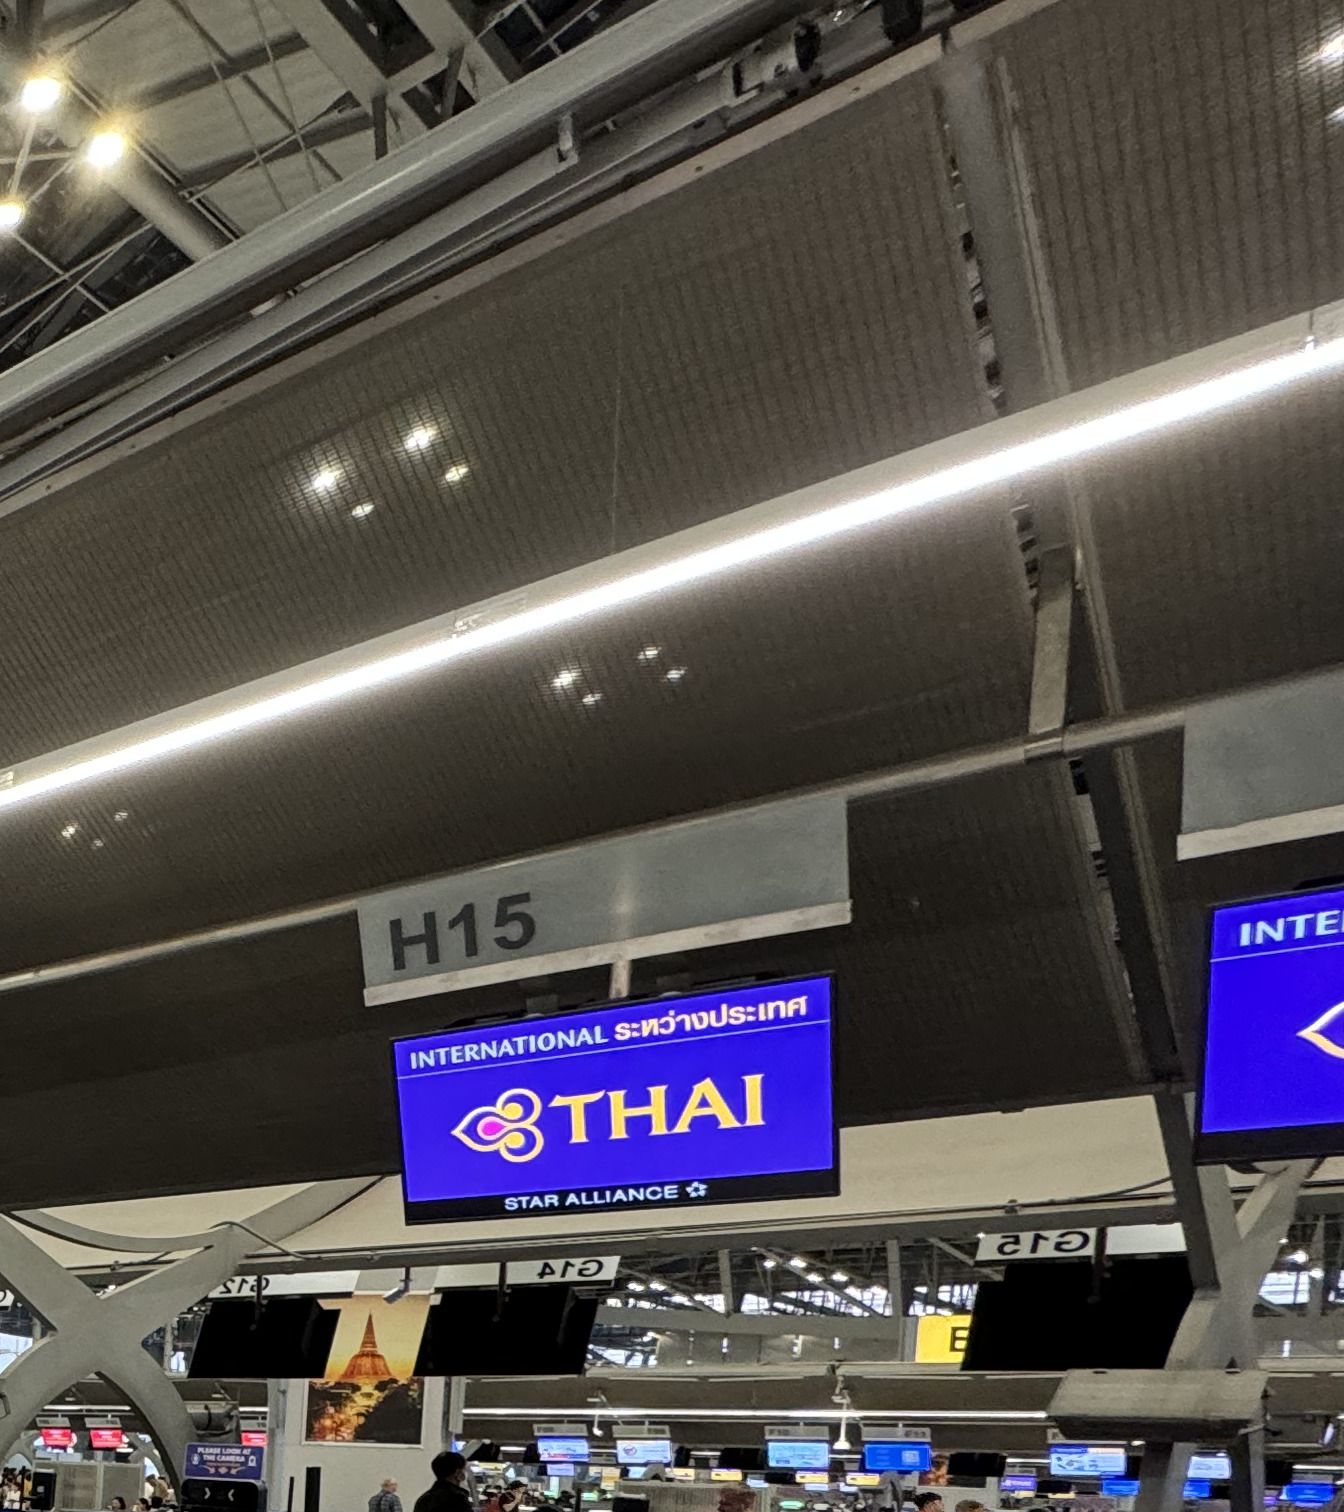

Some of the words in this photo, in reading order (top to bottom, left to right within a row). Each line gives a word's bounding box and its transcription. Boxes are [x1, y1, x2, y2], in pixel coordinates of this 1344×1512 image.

[389, 892, 537, 970] H15
[1238, 909, 1344, 947] INTE
[409, 1026, 609, 1071] INTERNATIONAL
[614, 995, 809, 1042] ระหว่างประเทศ
[549, 1073, 765, 1144] THAI
[504, 1194, 560, 1212] STAR
[565, 1184, 680, 1208] ALLIANCE
